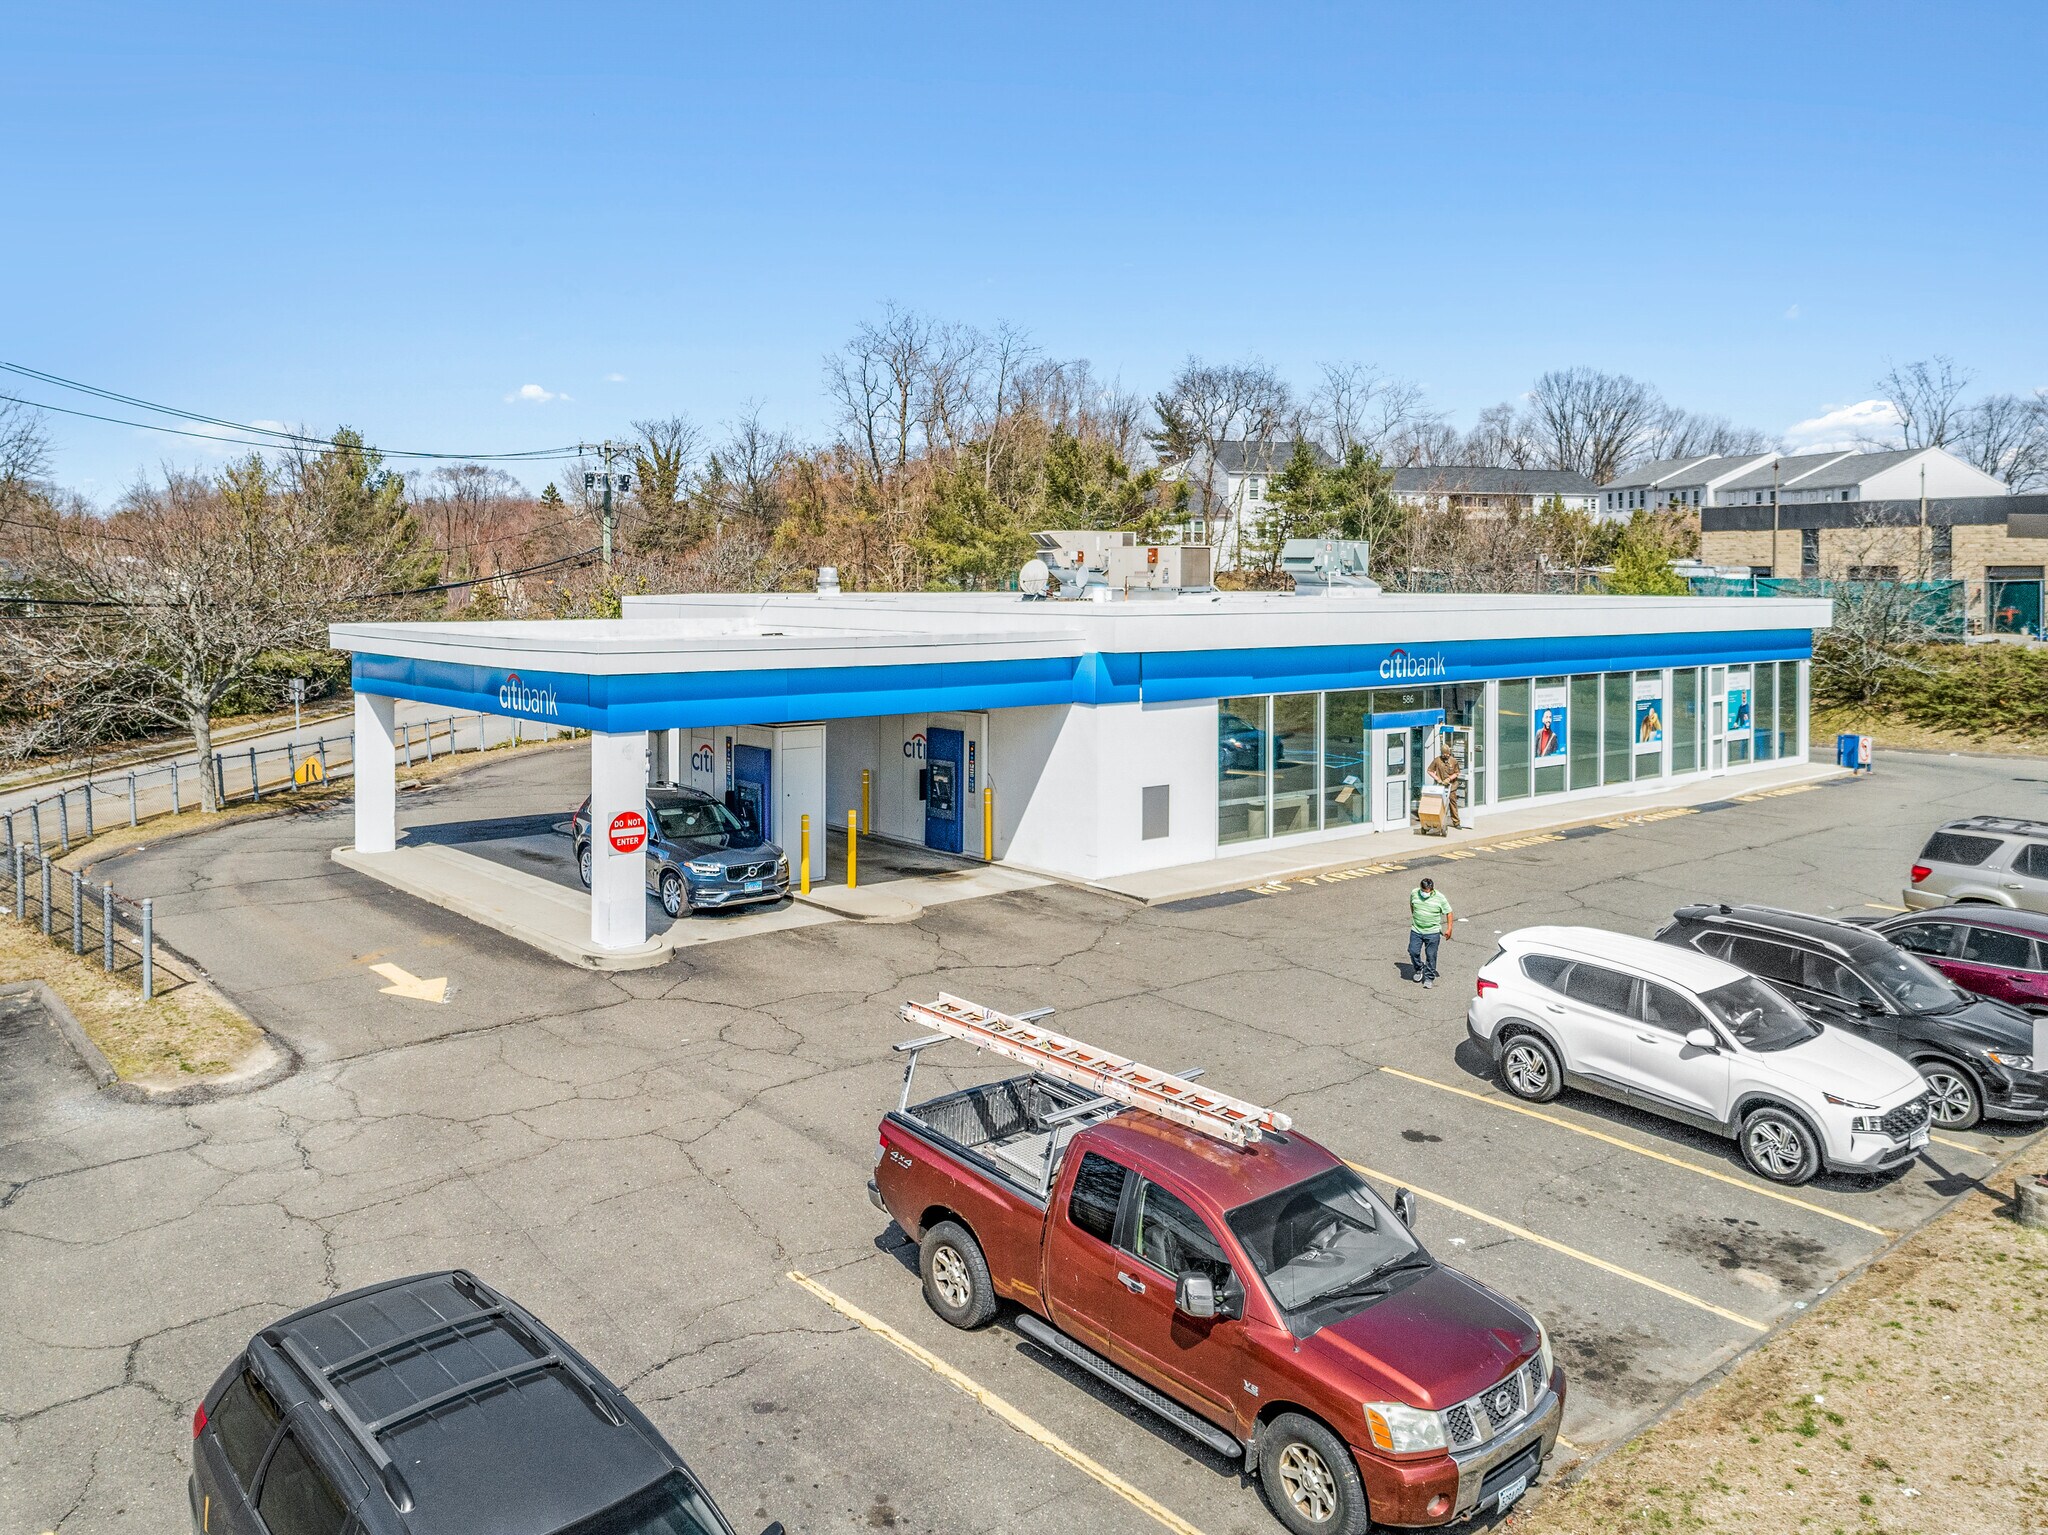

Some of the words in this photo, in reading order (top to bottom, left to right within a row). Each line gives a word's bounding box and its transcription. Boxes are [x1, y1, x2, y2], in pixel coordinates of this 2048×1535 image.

[1380, 650, 1446, 679] citibank
[499, 677, 558, 716] citibank
[1402, 694, 1414, 704] 586
[692, 748, 712, 773] citi
[903, 738, 926, 760] citi
[614, 820, 624, 828] DO
[627, 818, 641, 827] NOT
[616, 837, 639, 846] ENTER
[1438, 850, 1477, 860] NO
[1473, 834, 1567, 853] PARKING
